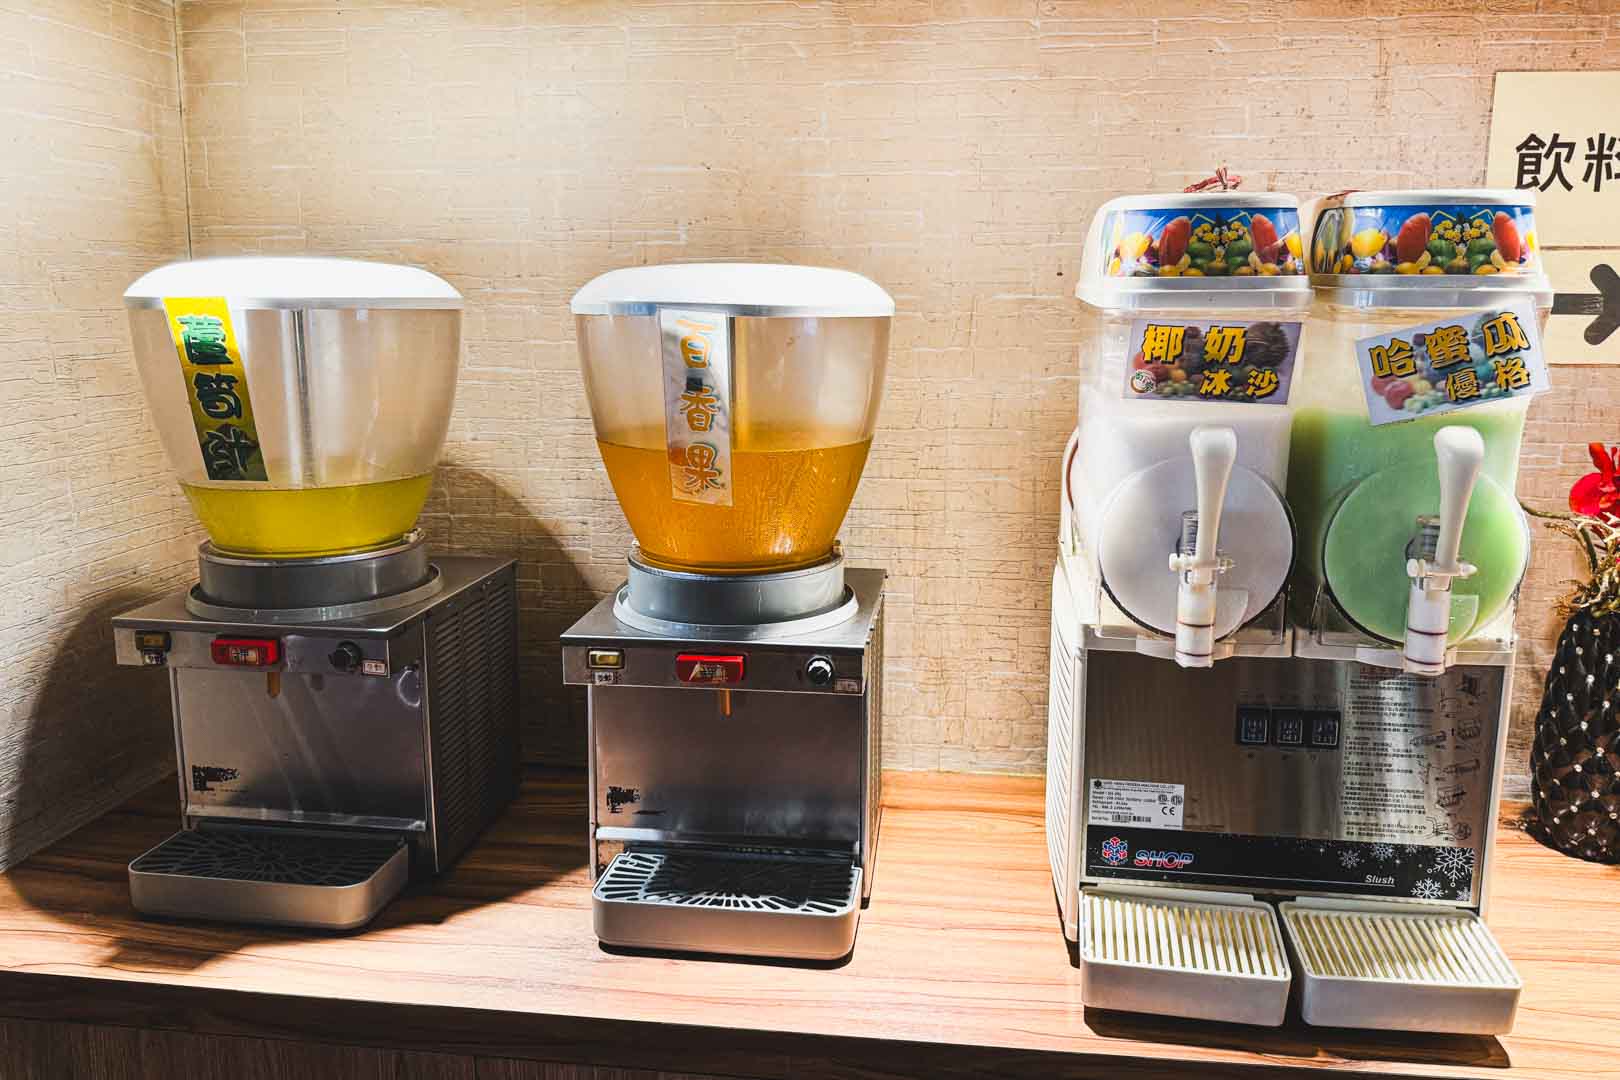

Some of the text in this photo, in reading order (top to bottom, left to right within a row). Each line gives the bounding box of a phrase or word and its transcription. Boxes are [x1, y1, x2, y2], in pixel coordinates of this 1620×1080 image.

[1142, 324, 1248, 364] 椰奶
[1368, 311, 1530, 378] 哈蜜瓜
[1200, 368, 1280, 397] 冰沙
[1446, 356, 1530, 401] 優格
[675, 318, 724, 490] 百香果
[1134, 849, 1194, 869] SHOP
[1365, 874, 1395, 885] Slush
